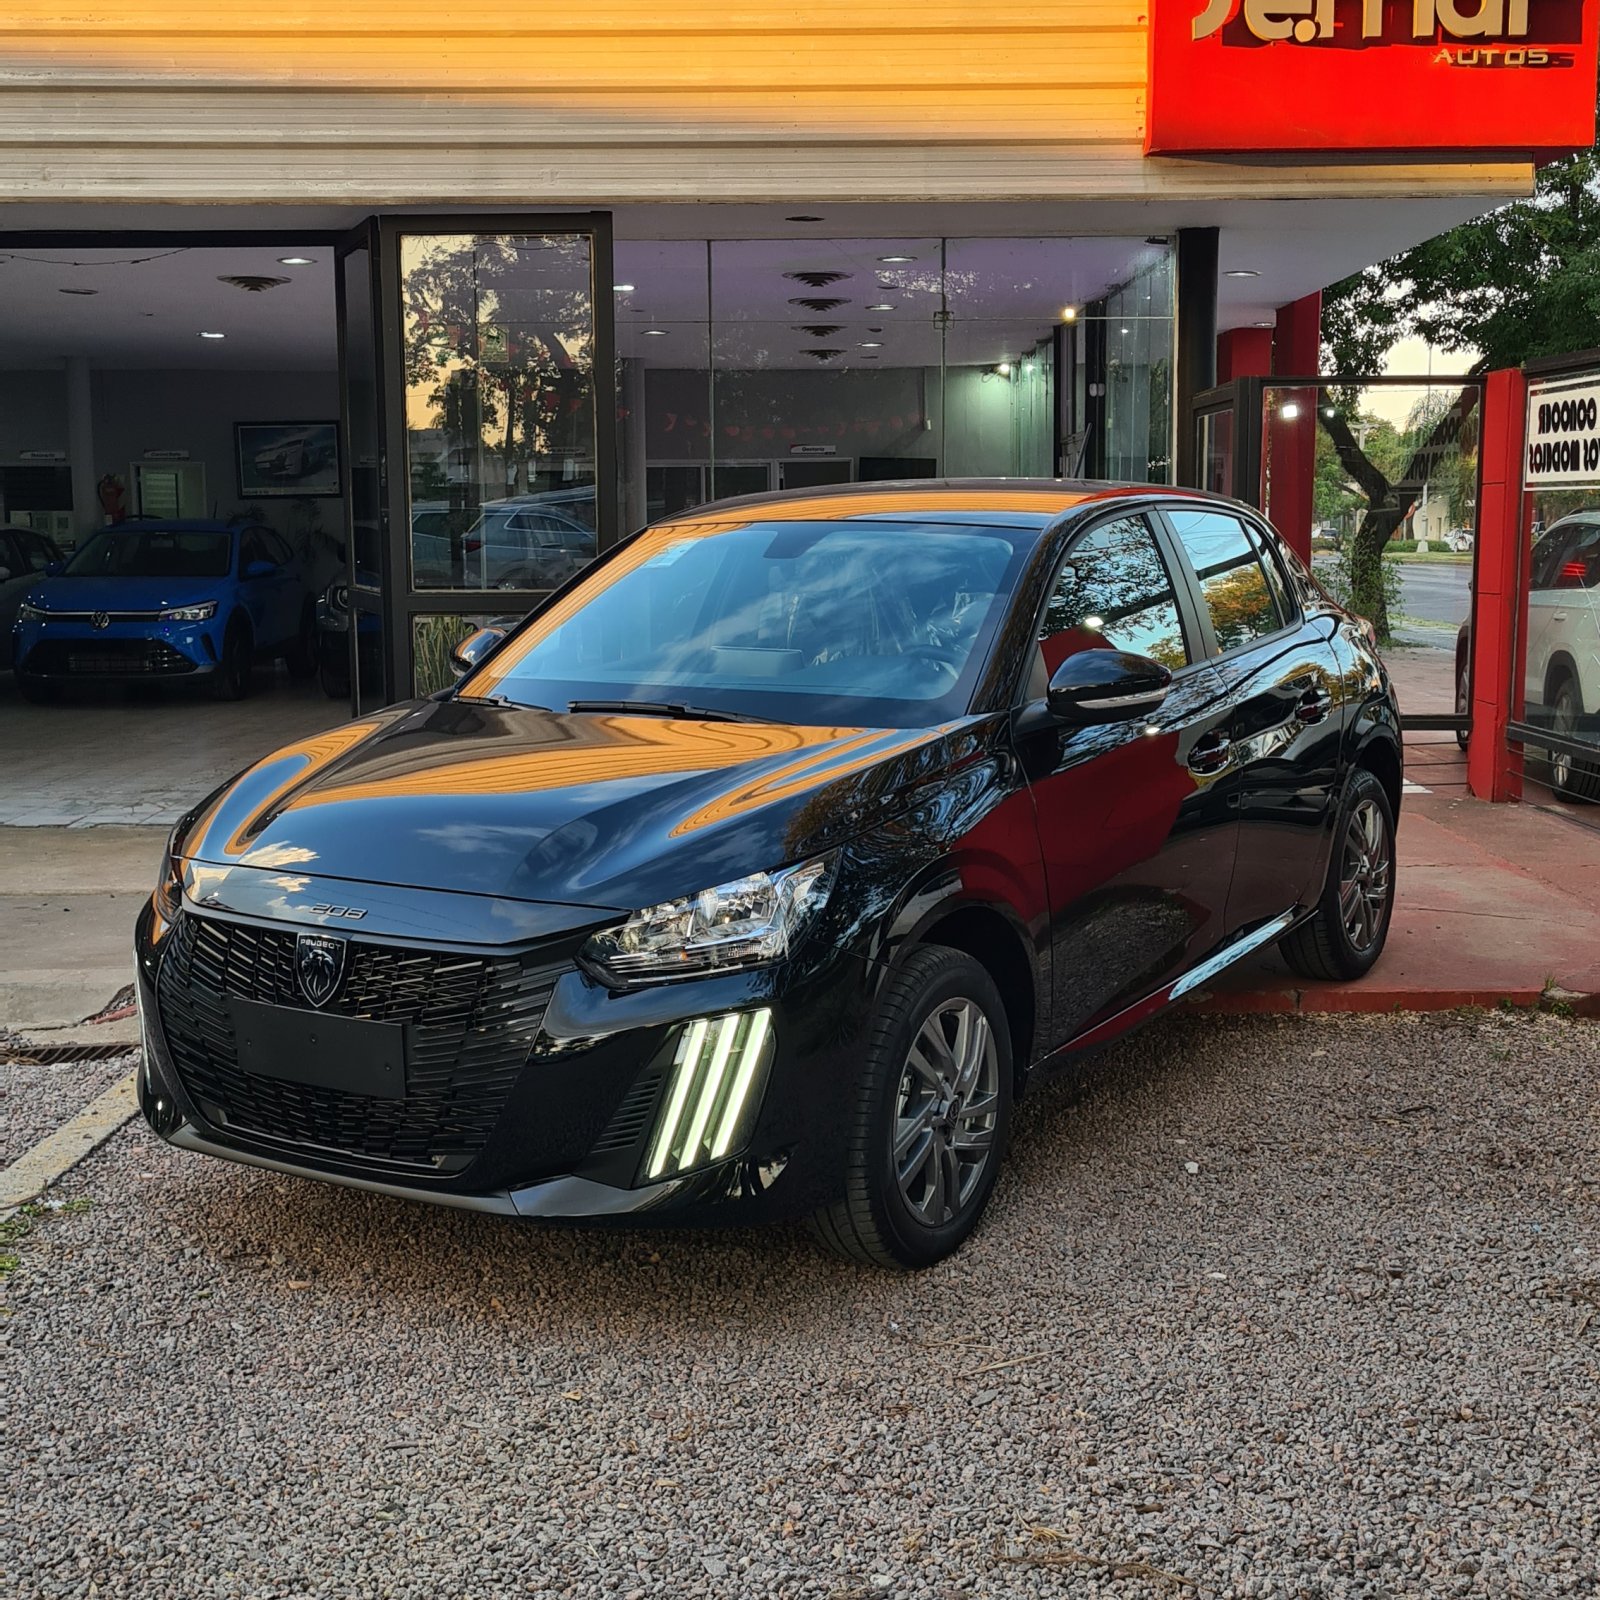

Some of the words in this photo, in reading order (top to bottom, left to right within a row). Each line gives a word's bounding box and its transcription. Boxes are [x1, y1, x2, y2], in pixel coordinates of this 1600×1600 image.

[1433, 48, 1549, 66] AUTOS
[309, 903, 368, 920] 208
[300, 938, 342, 950] PEUGEOT
